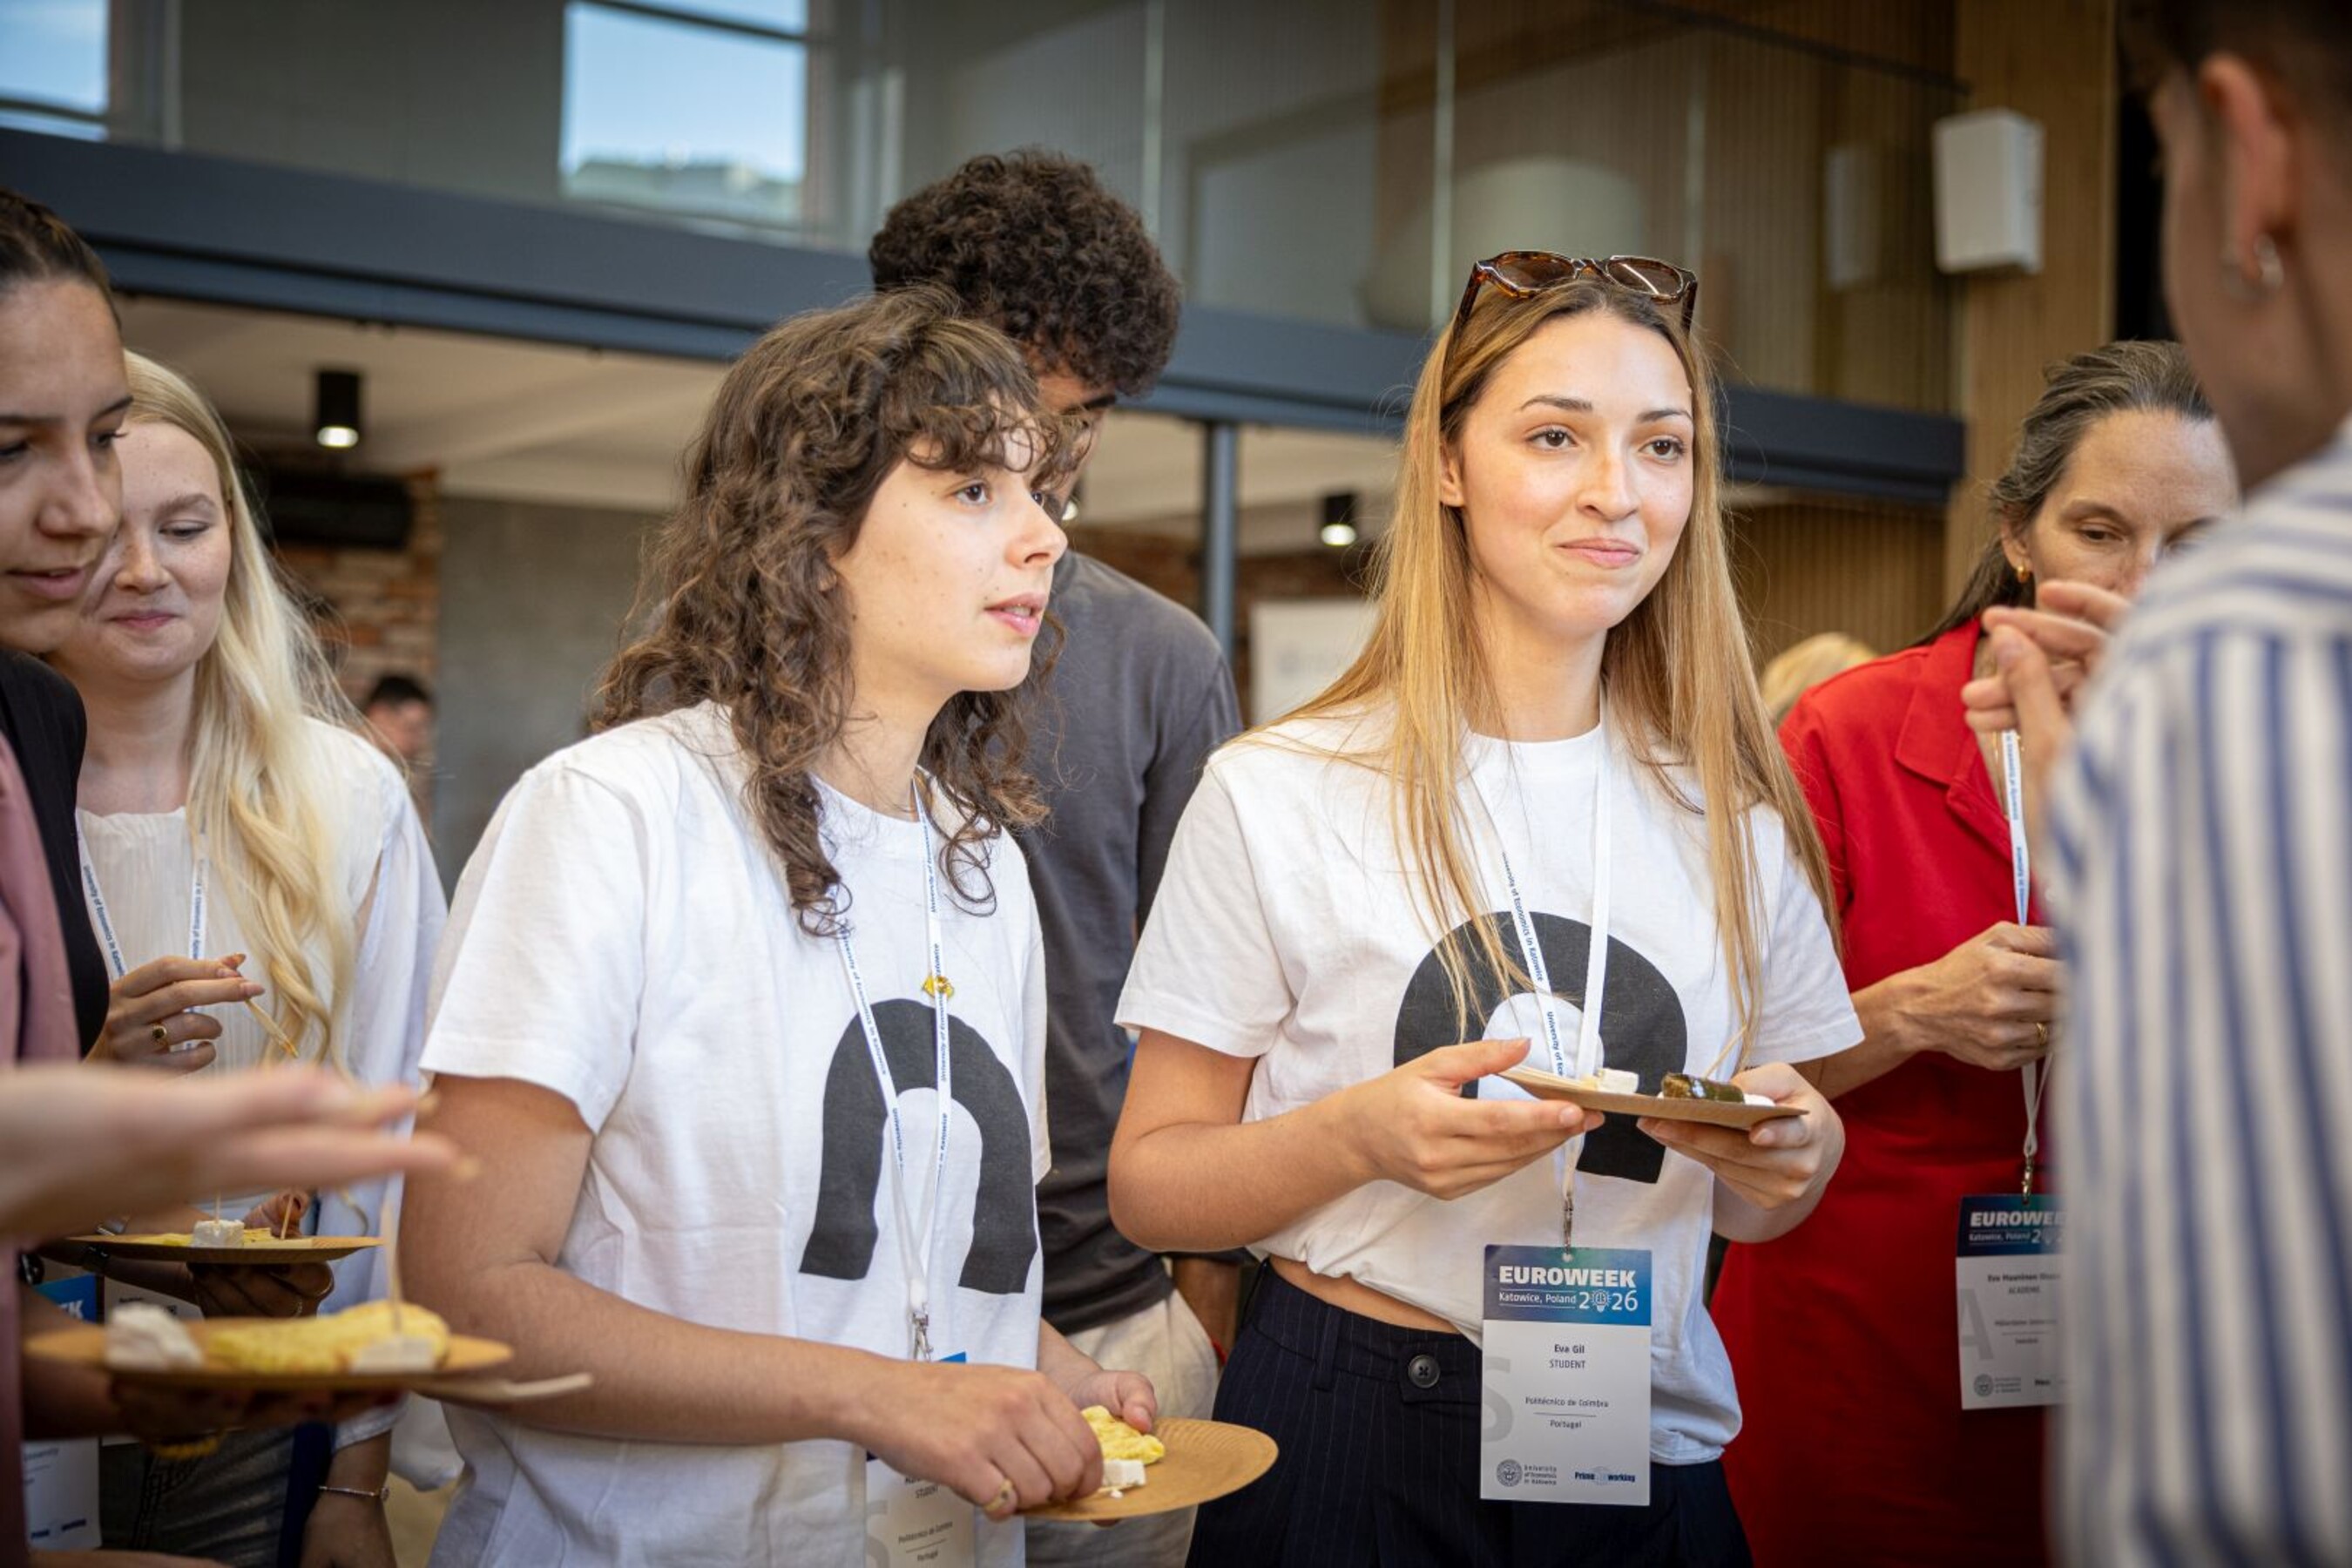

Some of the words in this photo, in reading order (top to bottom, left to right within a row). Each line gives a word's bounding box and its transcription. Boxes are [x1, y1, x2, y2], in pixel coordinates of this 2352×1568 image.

[1514, 897, 1531, 936] Economics
[1525, 937, 1534, 946] in
[1528, 947, 1544, 982] Katowice
[1547, 1011, 1560, 1051] University
[1554, 1051, 1563, 1061] of
[1498, 1266, 1637, 1288] EUROWEEK
[1499, 1292, 1543, 1304] Katowice,
[1545, 1294, 1577, 1304] Poland
[1554, 1344, 1570, 1353] Eva
[1571, 1345, 1585, 1354] Gil
[1550, 1359, 1586, 1369] STUDENT
[1550, 1419, 1583, 1429] Portugal
